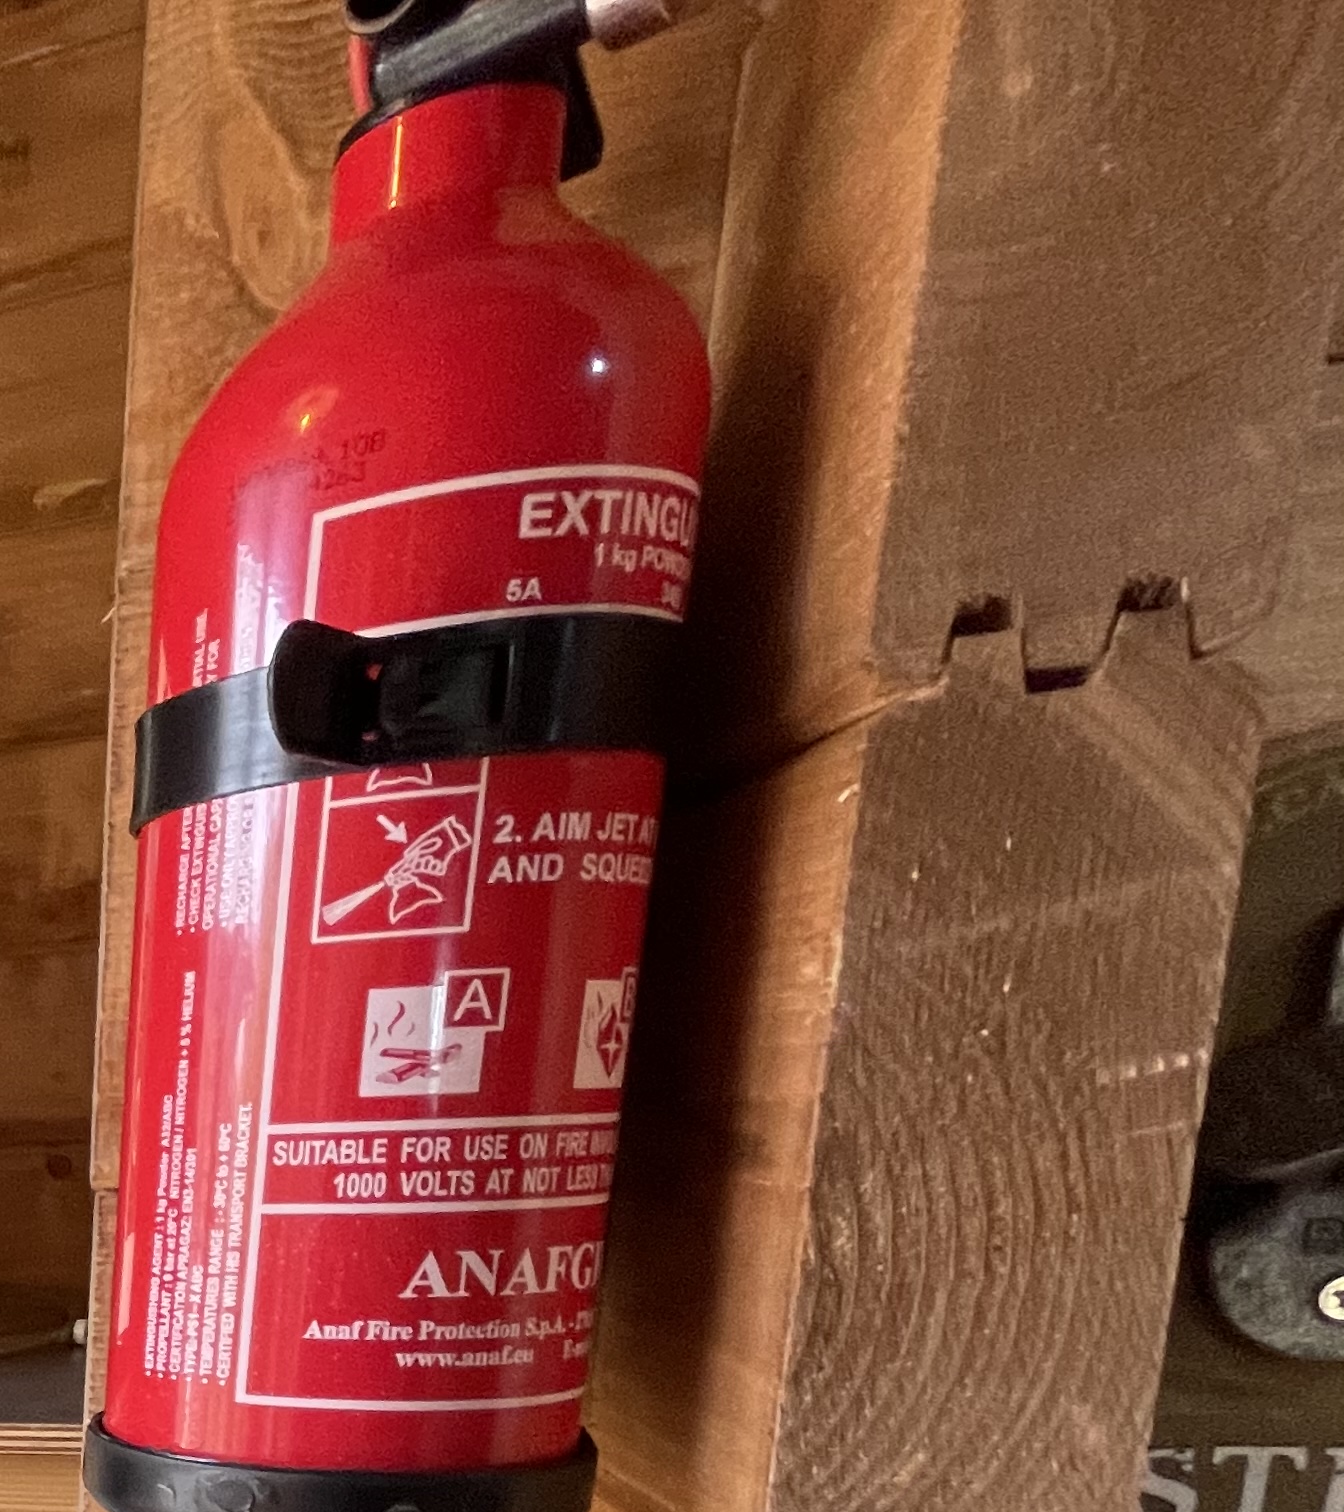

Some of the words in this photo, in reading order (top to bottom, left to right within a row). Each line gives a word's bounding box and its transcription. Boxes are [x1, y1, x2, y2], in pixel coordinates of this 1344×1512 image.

[611, 542, 637, 573] kg
[493, 814, 522, 844] 2.
[531, 811, 592, 842] AIM
[596, 811, 640, 843] JET
[487, 853, 564, 884] AND
[453, 978, 493, 1022] A
[272, 1137, 388, 1167] SUITABLE
[400, 1135, 452, 1164] FOR
[463, 1133, 509, 1162] USE
[519, 1132, 549, 1160] ON
[332, 1172, 387, 1199] 1000
[400, 1170, 475, 1197] VOLTS
[484, 1167, 514, 1196] AT
[522, 1166, 560, 1194] NOT
[302, 1319, 364, 1341] Anaf
[365, 1319, 413, 1341] Fire
[418, 1318, 520, 1341] Protection
